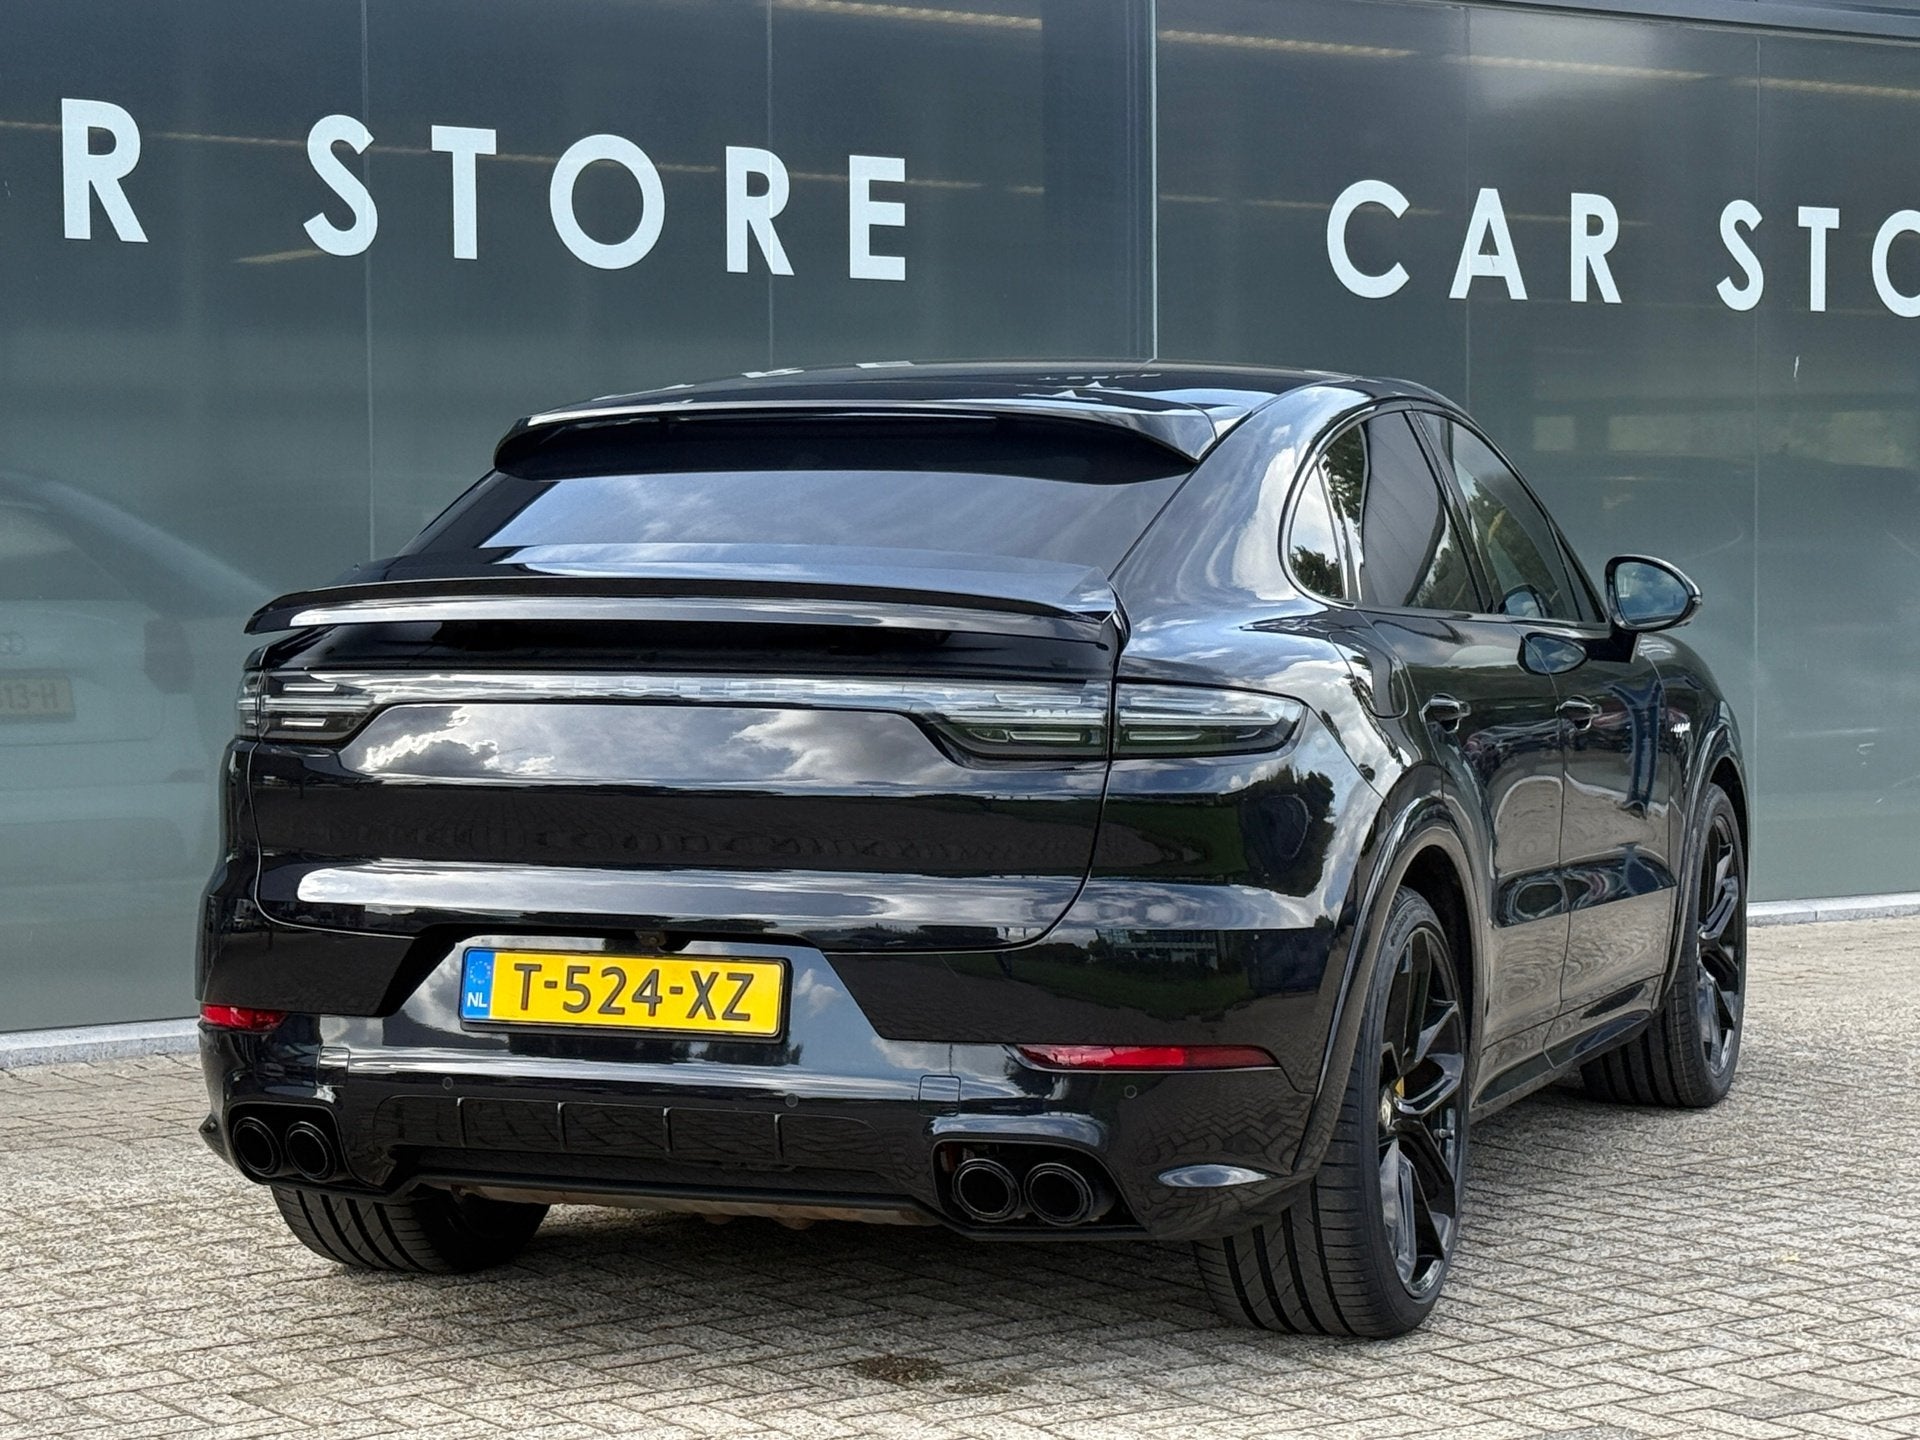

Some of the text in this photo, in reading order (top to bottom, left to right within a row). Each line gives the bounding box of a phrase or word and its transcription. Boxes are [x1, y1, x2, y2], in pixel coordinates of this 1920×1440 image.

[61, 97, 906, 281] R STORE
[1326, 179, 1920, 318] CAR STO
[467, 991, 488, 1008] NL
[513, 963, 755, 1022] T-524-XZ
